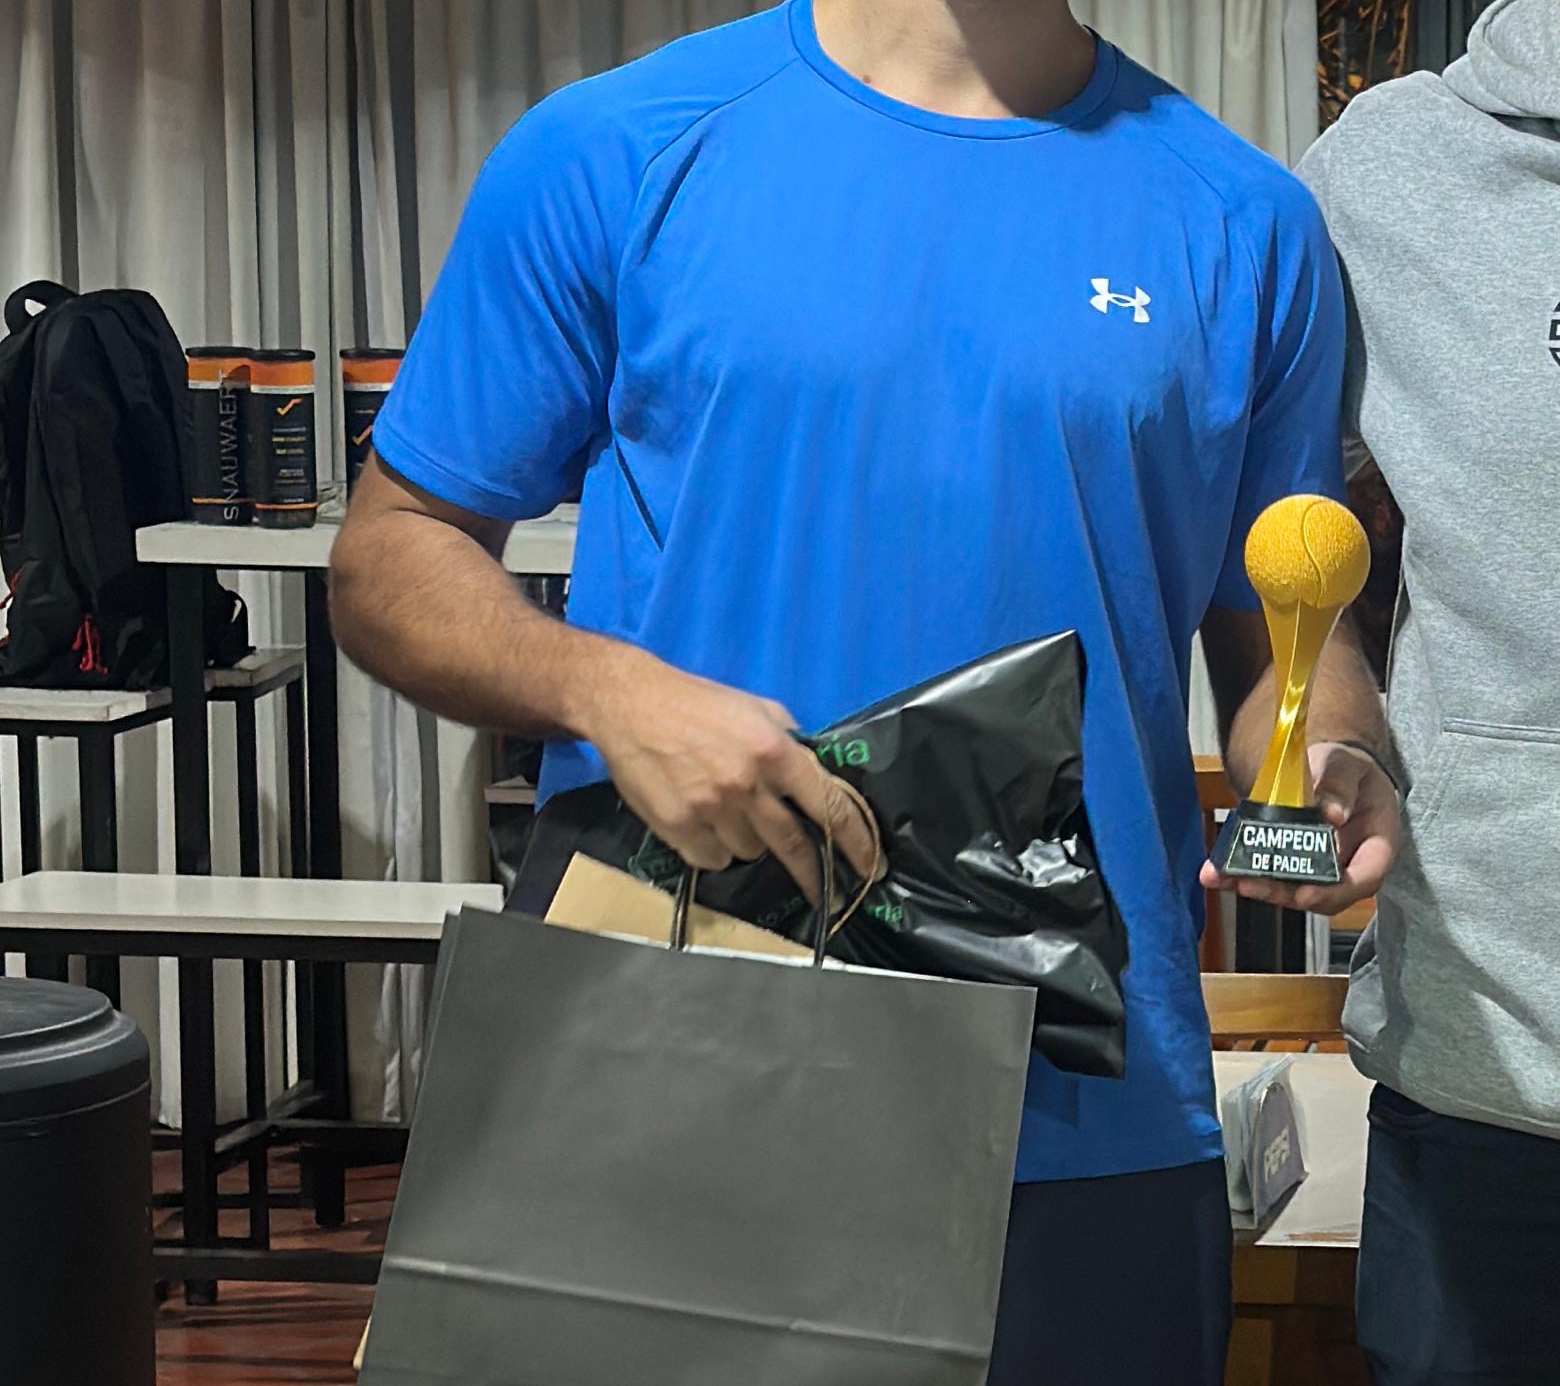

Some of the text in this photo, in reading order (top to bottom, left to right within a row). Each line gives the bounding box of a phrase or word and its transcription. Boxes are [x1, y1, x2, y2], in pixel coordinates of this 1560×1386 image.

[1243, 826, 1327, 852] CAMPEON
[1252, 853, 1314, 874] DE PADEL
